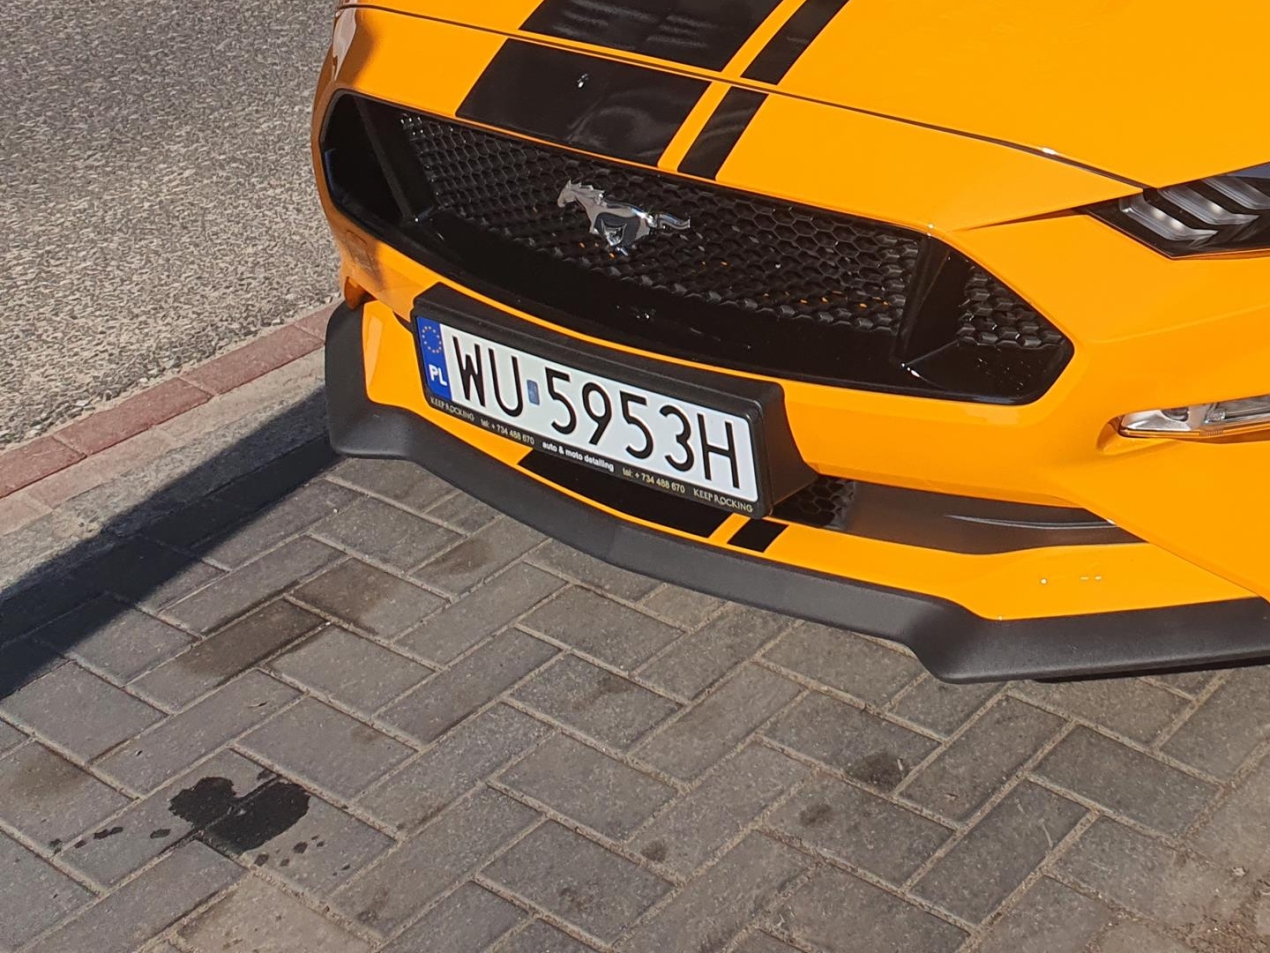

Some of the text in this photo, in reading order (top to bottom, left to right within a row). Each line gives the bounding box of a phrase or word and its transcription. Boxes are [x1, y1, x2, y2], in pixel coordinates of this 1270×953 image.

[428, 363, 447, 386] PL
[452, 336, 740, 490] WU 5953H
[542, 441, 557, 452] auto
[565, 449, 583, 461] moto
[584, 454, 614, 472] detailing
[641, 473, 655, 485] 734
[656, 478, 670, 490] 488
[671, 482, 686, 494] 670
[693, 487, 713, 502] KEEP
[714, 495, 754, 513] ROCKING
